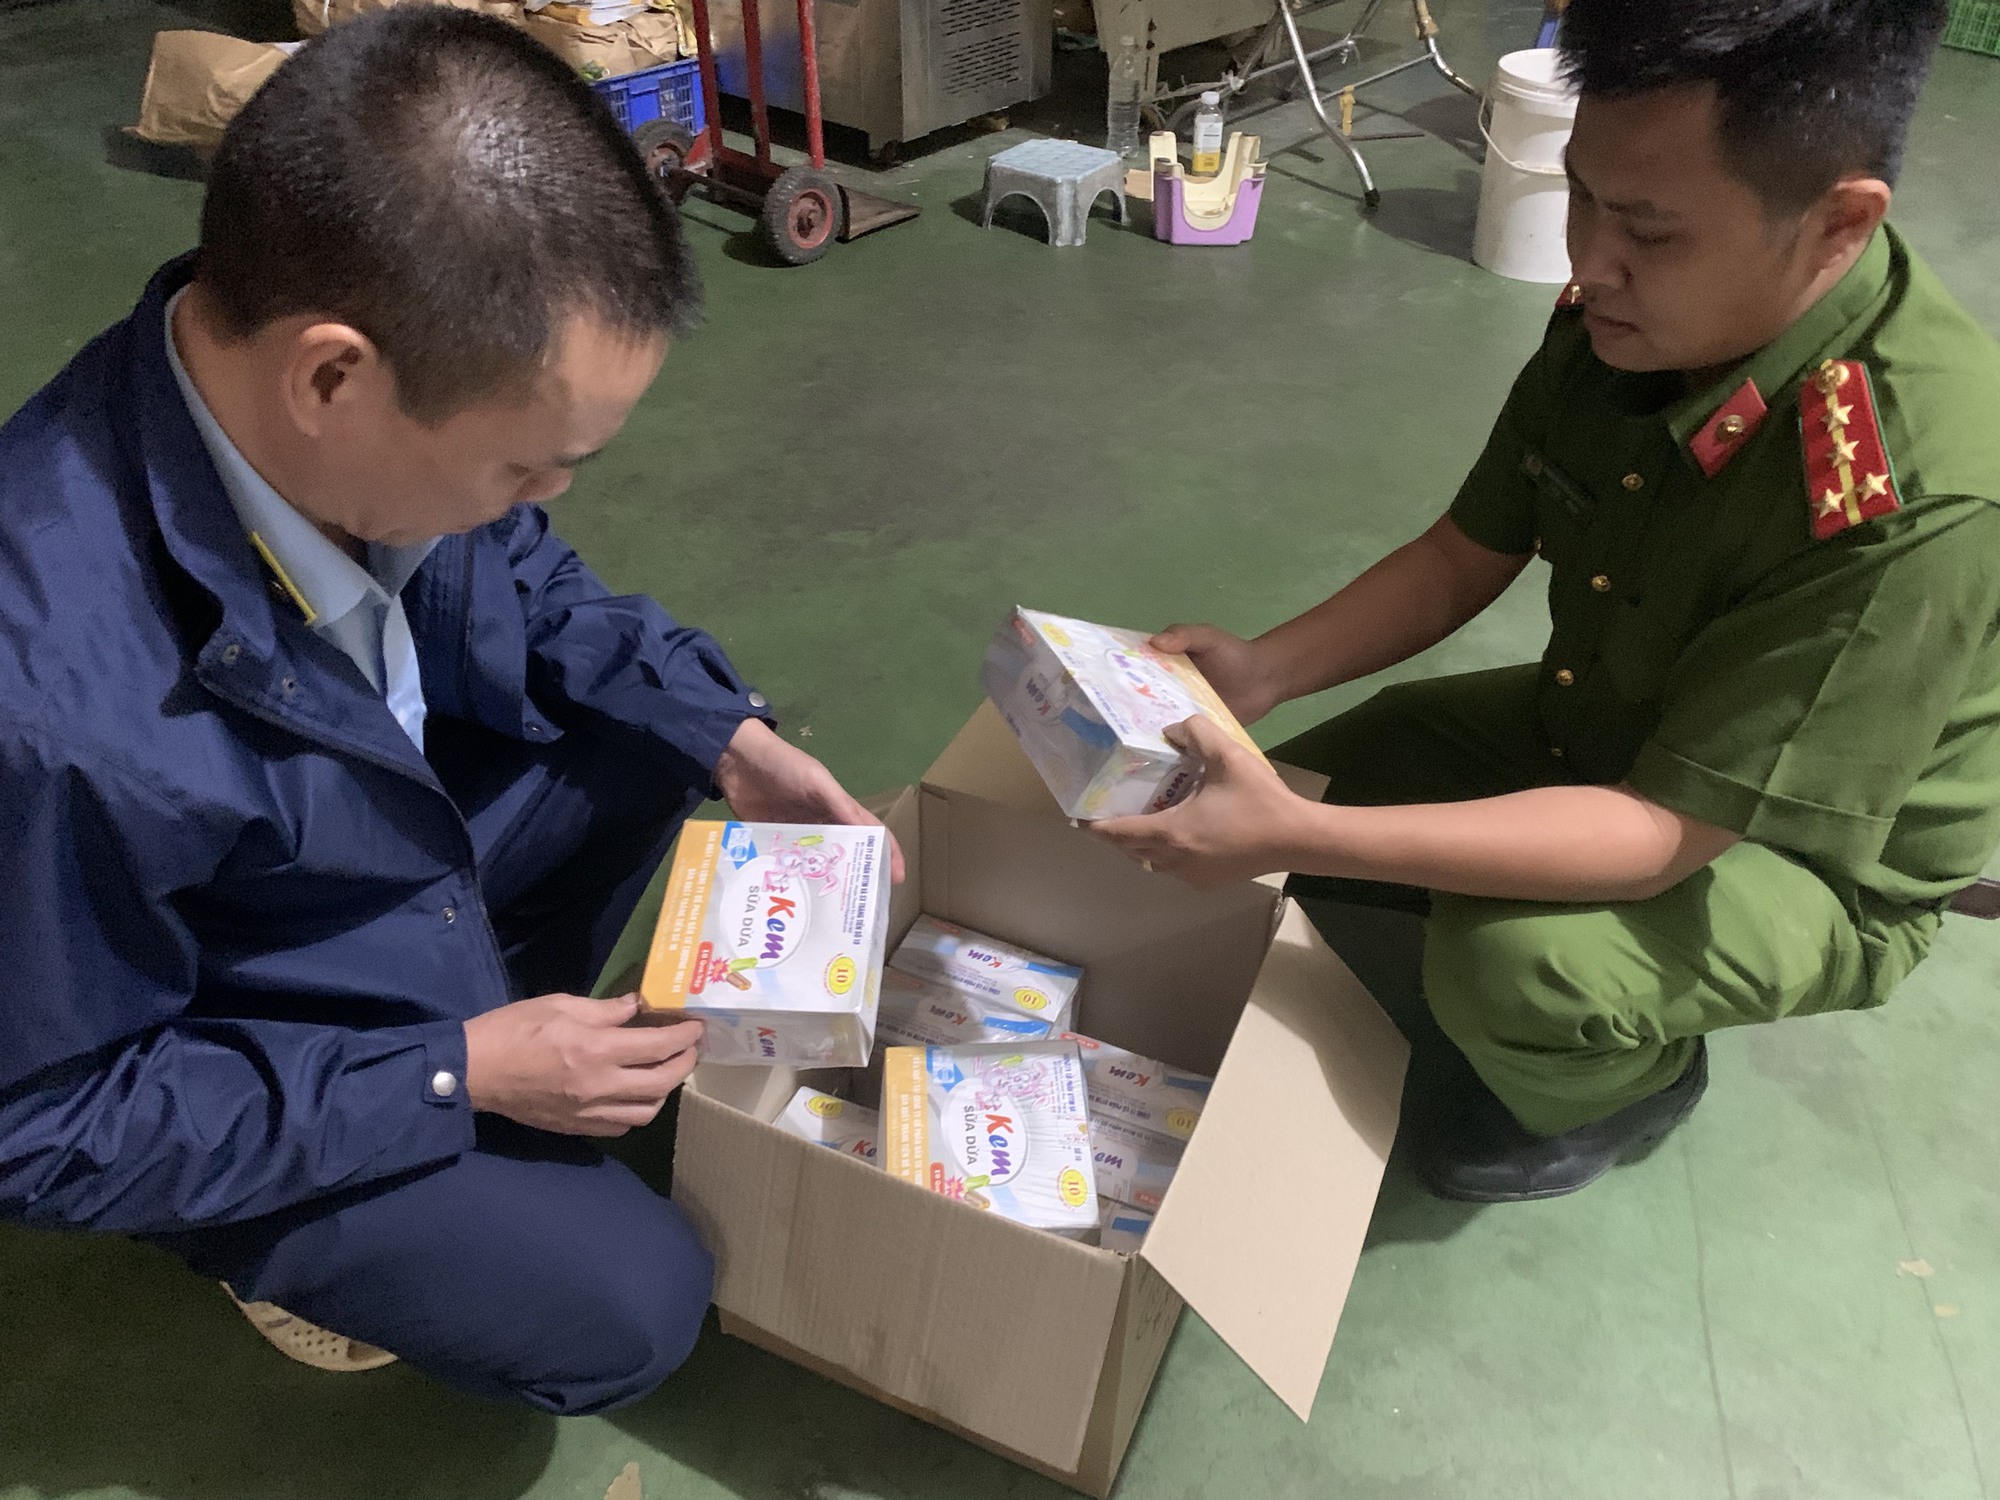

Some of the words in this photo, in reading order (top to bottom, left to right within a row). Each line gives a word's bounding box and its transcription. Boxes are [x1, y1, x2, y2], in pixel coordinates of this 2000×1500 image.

[1026, 678, 1051, 716] Kem
[745, 885, 761, 913] SỮA
[738, 917, 754, 947] DỪA
[760, 896, 796, 959] Kem
[968, 950, 1002, 968] Kem
[836, 968, 849, 983] 10
[1023, 994, 1038, 1005] 10
[930, 1005, 968, 1025] Kem
[757, 1027, 778, 1058] Kem
[1109, 1066, 1151, 1087] Kem
[964, 1105, 978, 1132] SỮA
[1176, 1117, 1192, 1130] 10
[852, 1140, 877, 1157] Ke
[966, 1136, 980, 1165] DỪA
[985, 1114, 1014, 1176] Kem
[1093, 1145, 1123, 1169] em
[1068, 1182, 1080, 1196] 10
